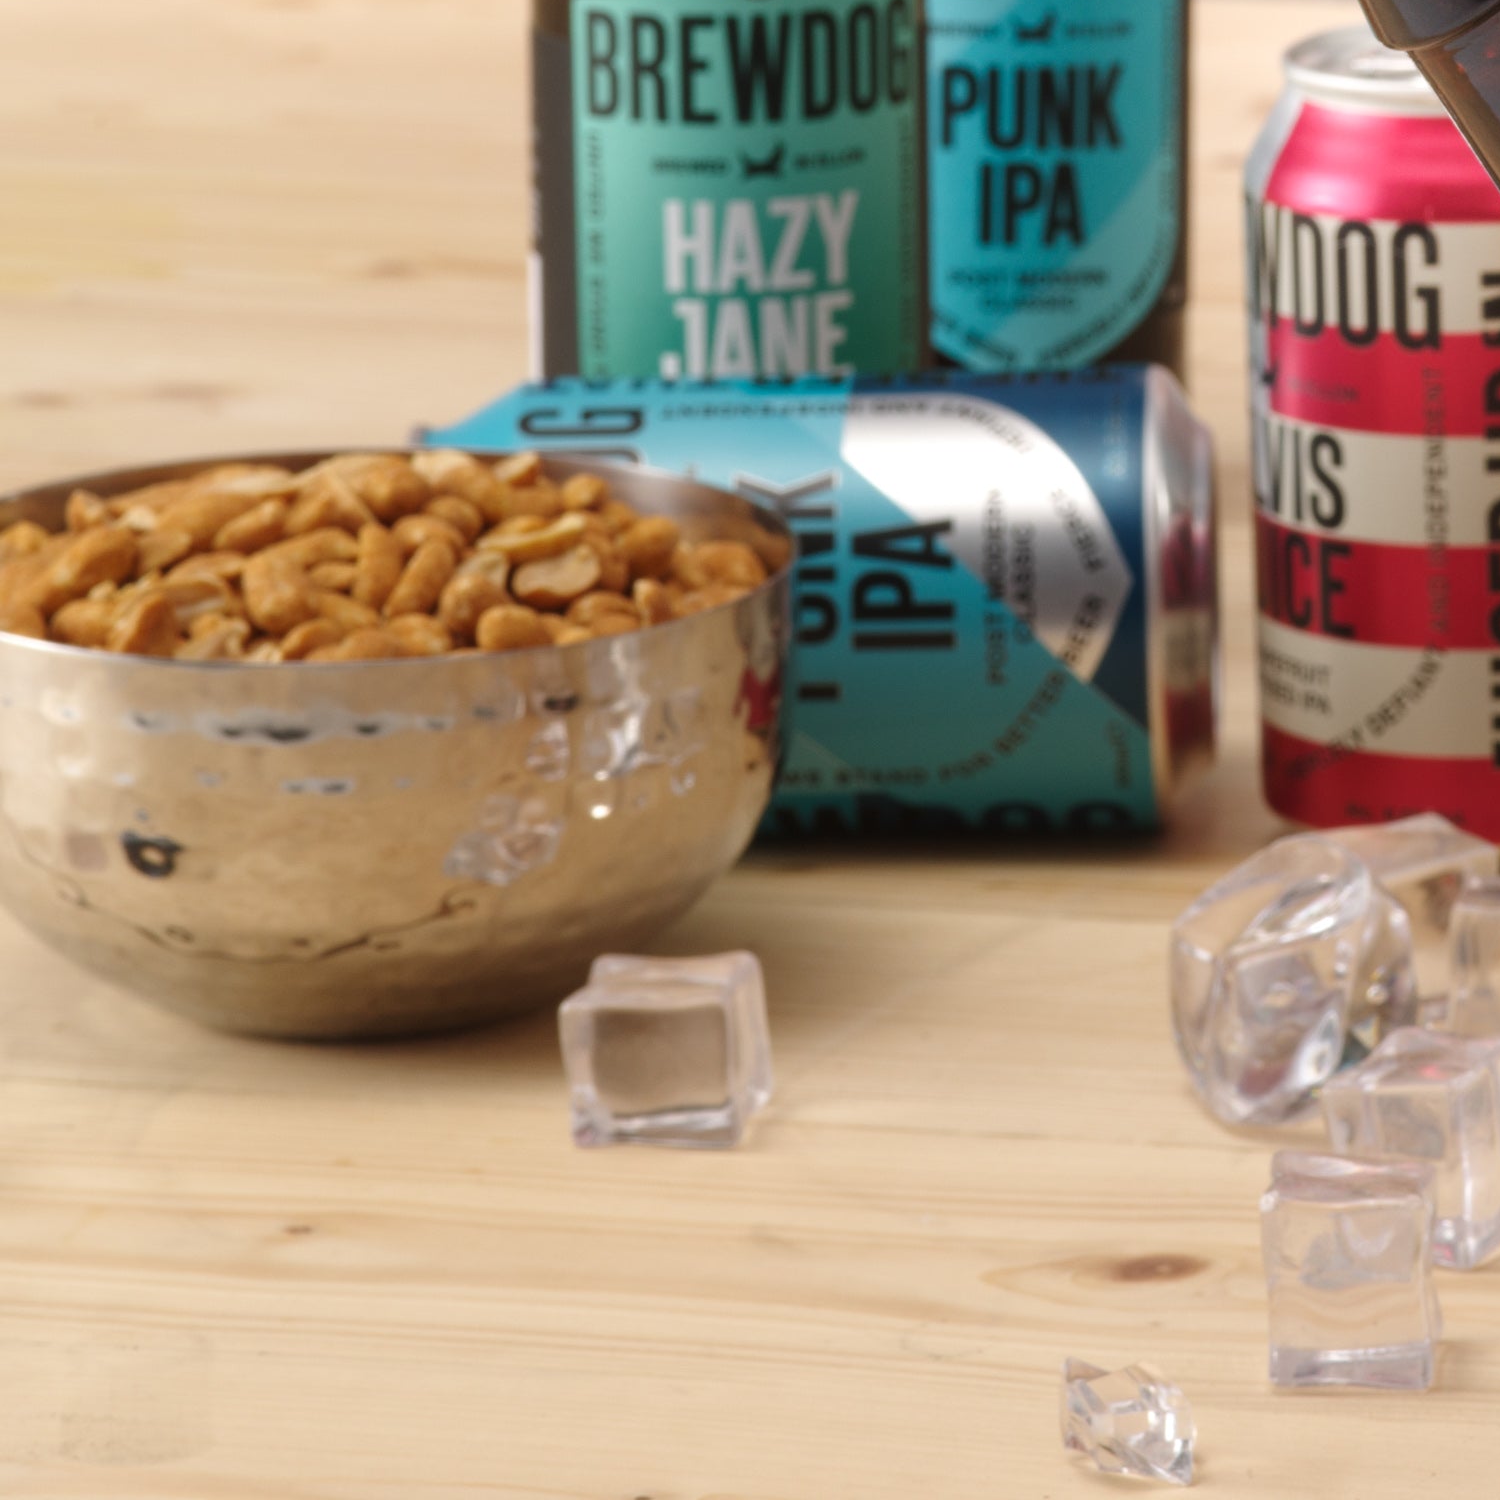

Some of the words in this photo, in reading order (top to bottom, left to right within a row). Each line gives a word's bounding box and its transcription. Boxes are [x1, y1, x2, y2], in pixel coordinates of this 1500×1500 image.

[939, 61, 1124, 151] PUNK
[662, 189, 859, 294] HAZY
[976, 161, 1087, 247] IPA
[658, 291, 855, 377] JANE
[852, 518, 958, 653] IPA
